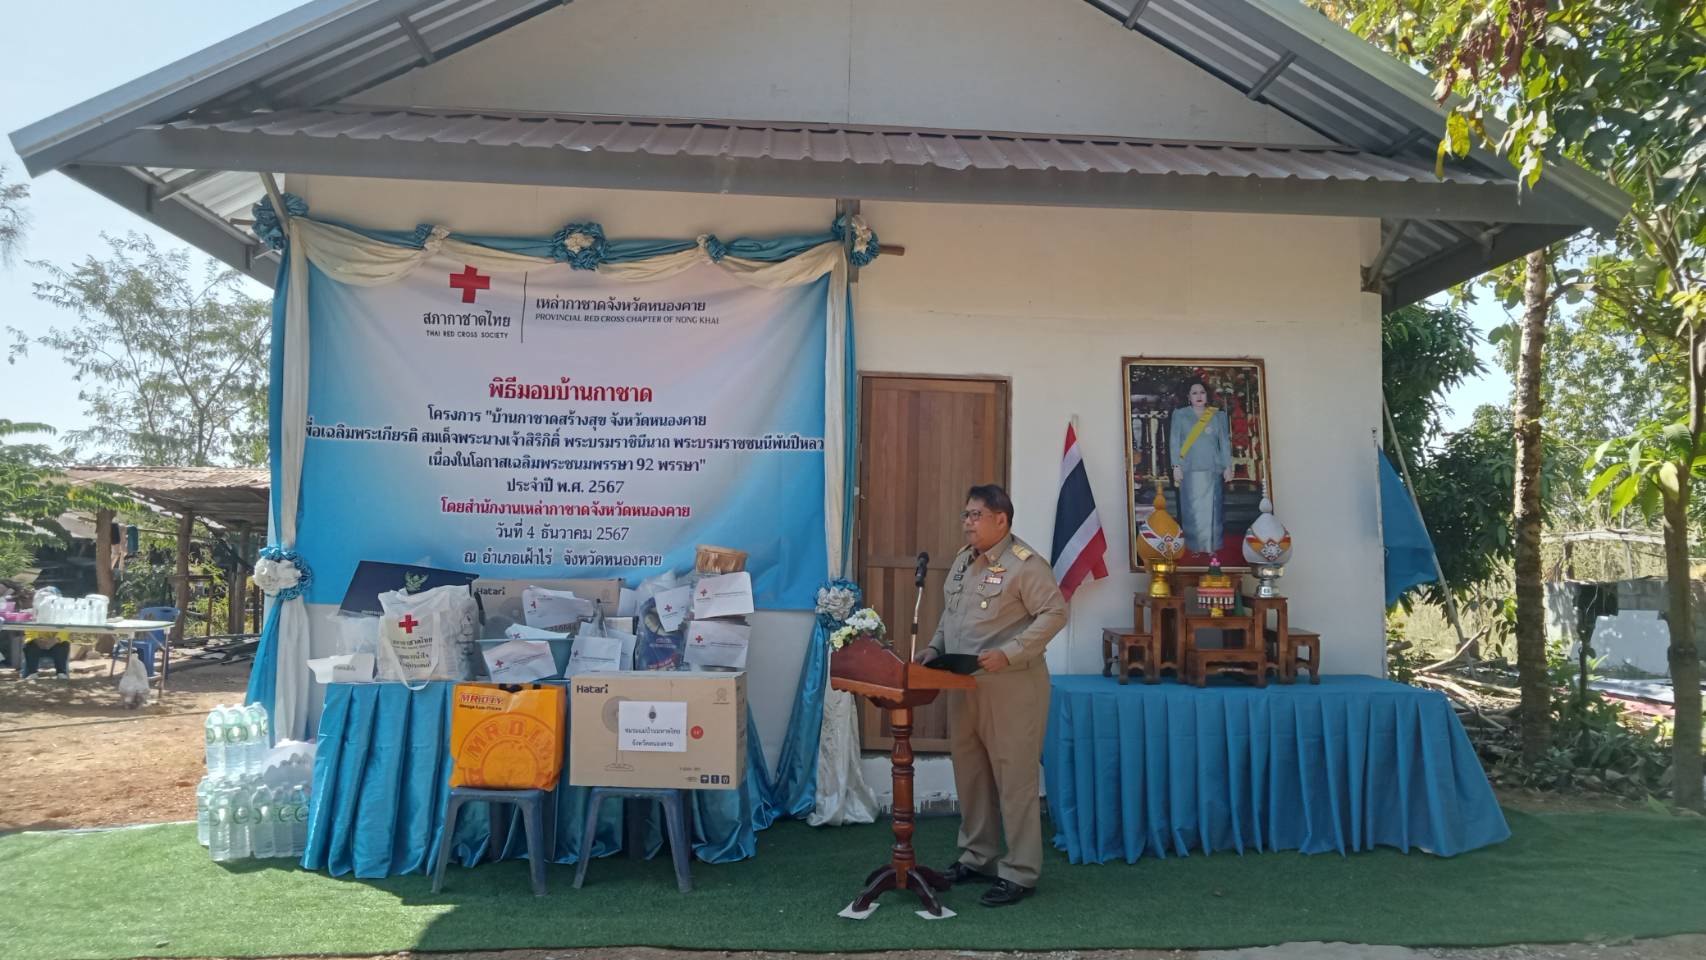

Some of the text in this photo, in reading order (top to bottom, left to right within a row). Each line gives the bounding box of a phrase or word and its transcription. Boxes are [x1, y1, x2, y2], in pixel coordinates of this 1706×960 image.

[536, 294, 706, 312] เหล่ากาชาดจังหวัดหนองคาย
[423, 309, 511, 328] สภากาชาดไทย
[535, 313, 720, 325] PROVINCIAL RED CROSS CHAPTER OF NONG KHAI
[488, 376, 653, 403] พิธีมอบบ้านกาชาด
[427, 403, 707, 431] โครงการ "บ้านกาชาดสร้างสุข จังหวัดหนองคาย
[305, 416, 825, 451] พื่อเฉลิมพระเกียรติ สมเด็จพระนางเจ้าสิริกิติ์ พระบรมราชินีนาถ พระบรมราชชนนีพันปีหลว
[428, 447, 707, 472] เนื่องในโอกาสเฉลิมพระชนมพรรษา 92 พรรษา"
[506, 477, 625, 494] ประจำปี พ.ศ. 2567
[440, 496, 691, 518] โดยสำนักงานเหล่ากาชาดจังหวัดหนองคาย
[495, 518, 630, 541] วันที่ 4 ธันวาคม 2567
[464, 546, 662, 567] ณ อำเภอเฝ้าไร่ จังหวัดหนองคาย
[576, 683, 609, 694] Hatari
